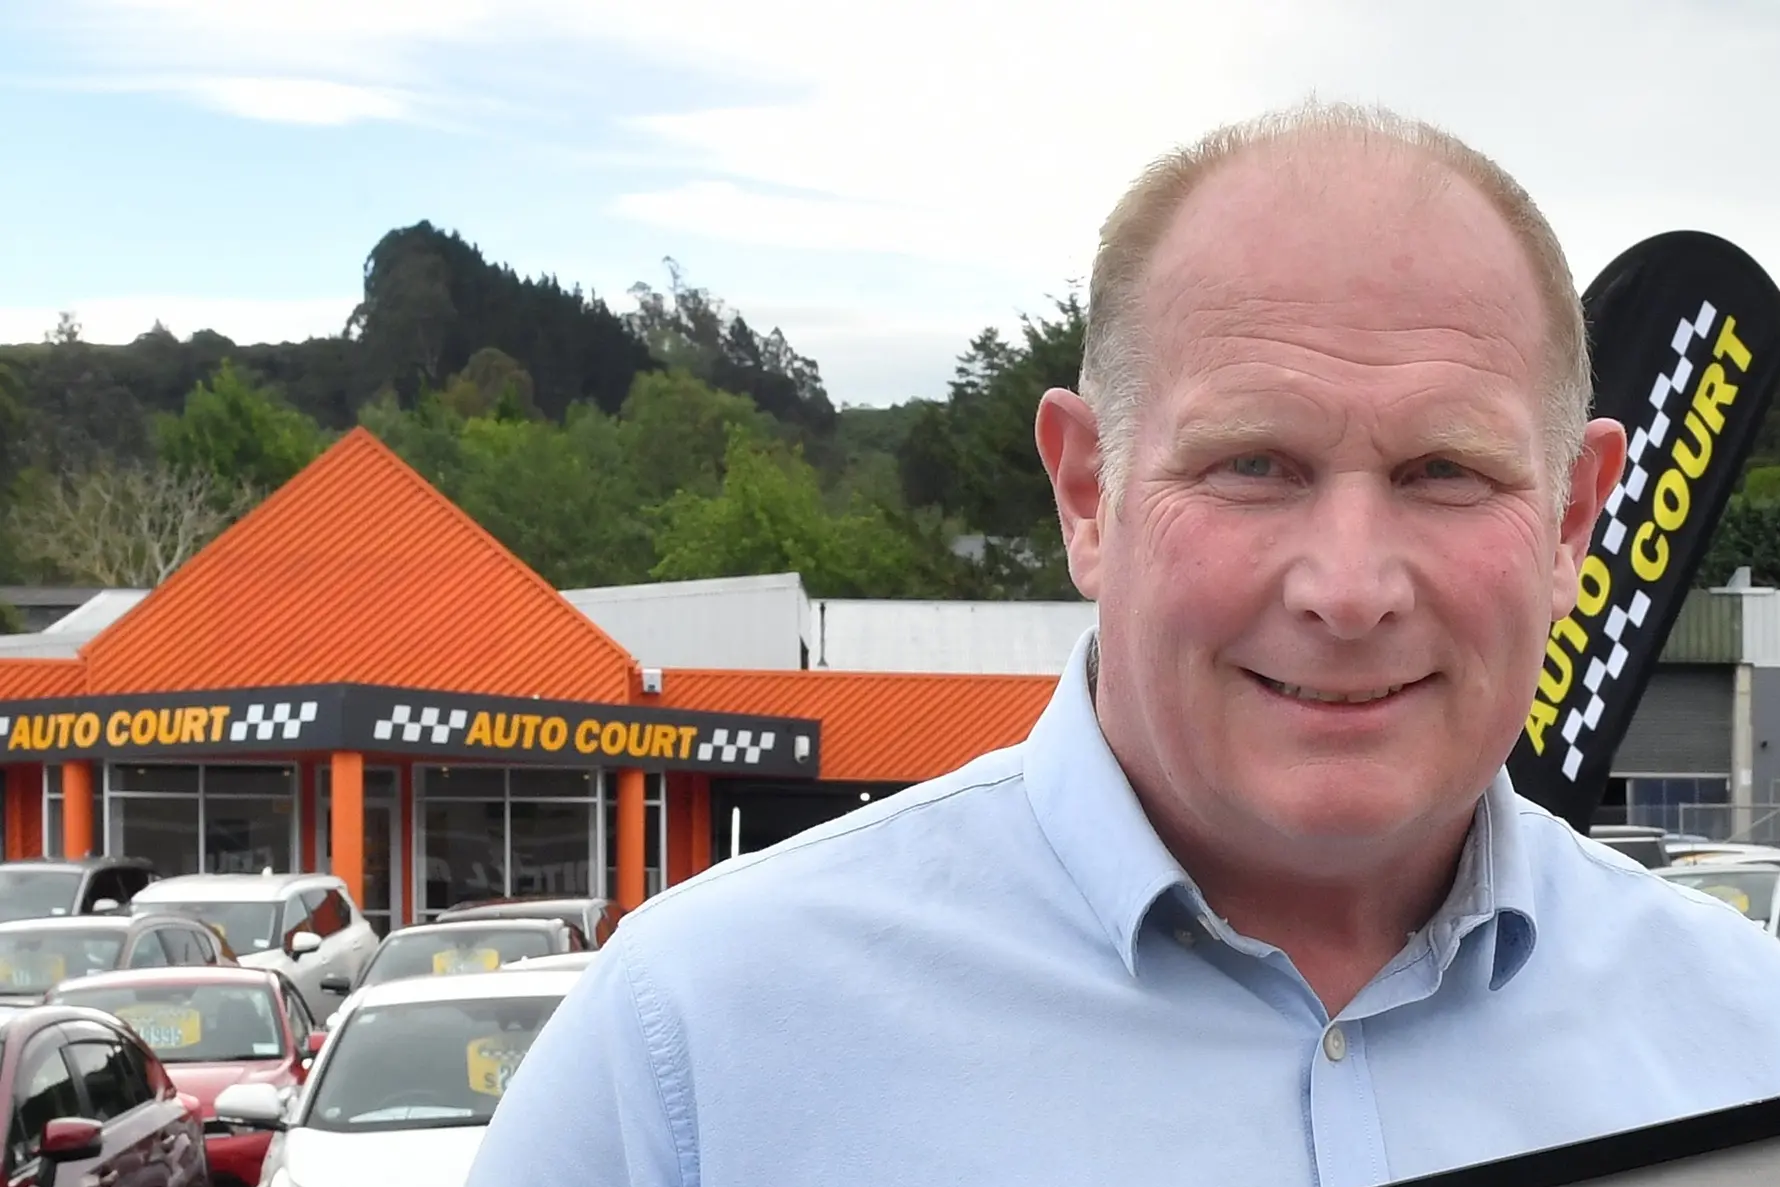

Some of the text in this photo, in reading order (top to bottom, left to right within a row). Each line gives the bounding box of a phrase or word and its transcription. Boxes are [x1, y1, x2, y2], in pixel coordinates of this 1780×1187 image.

[1630, 315, 1753, 583] COURT
[8, 705, 231, 751] AUTO COURT
[465, 710, 699, 760] AUTO COURT
